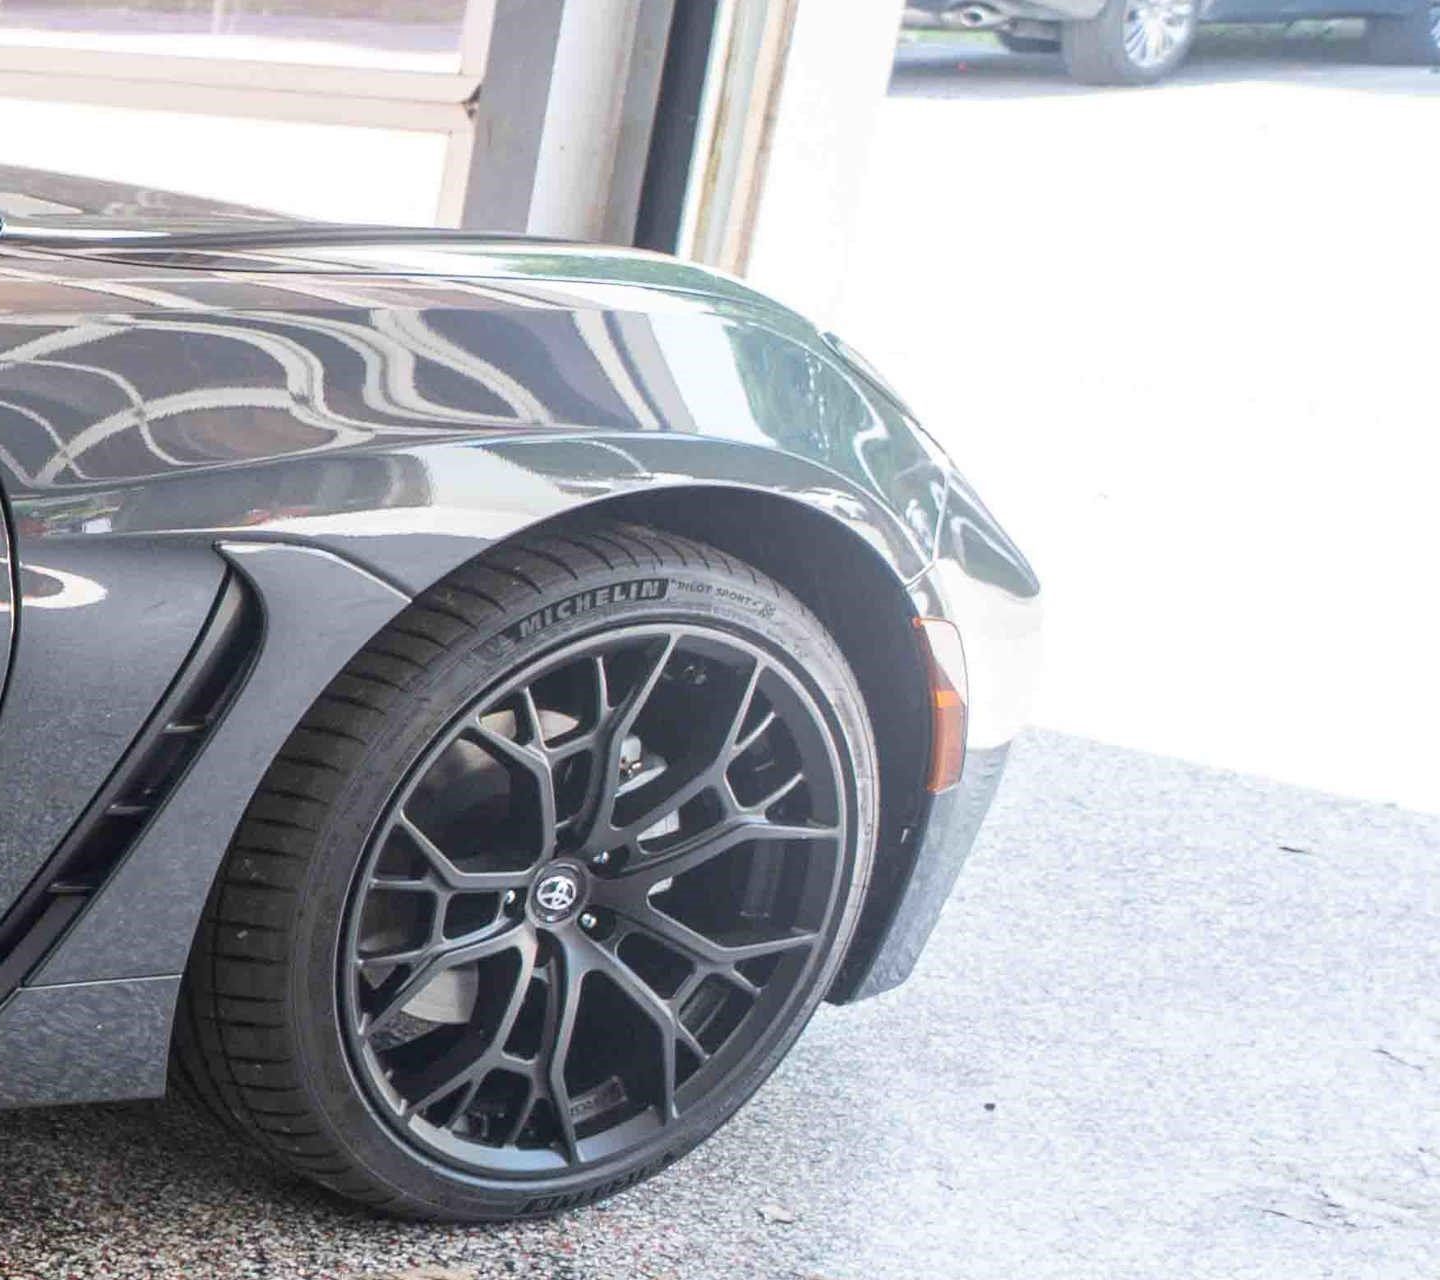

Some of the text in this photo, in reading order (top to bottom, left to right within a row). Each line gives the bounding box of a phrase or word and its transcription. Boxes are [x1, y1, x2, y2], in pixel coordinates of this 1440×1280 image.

[519, 580, 752, 638] MICHELIN PILOT SPORT
